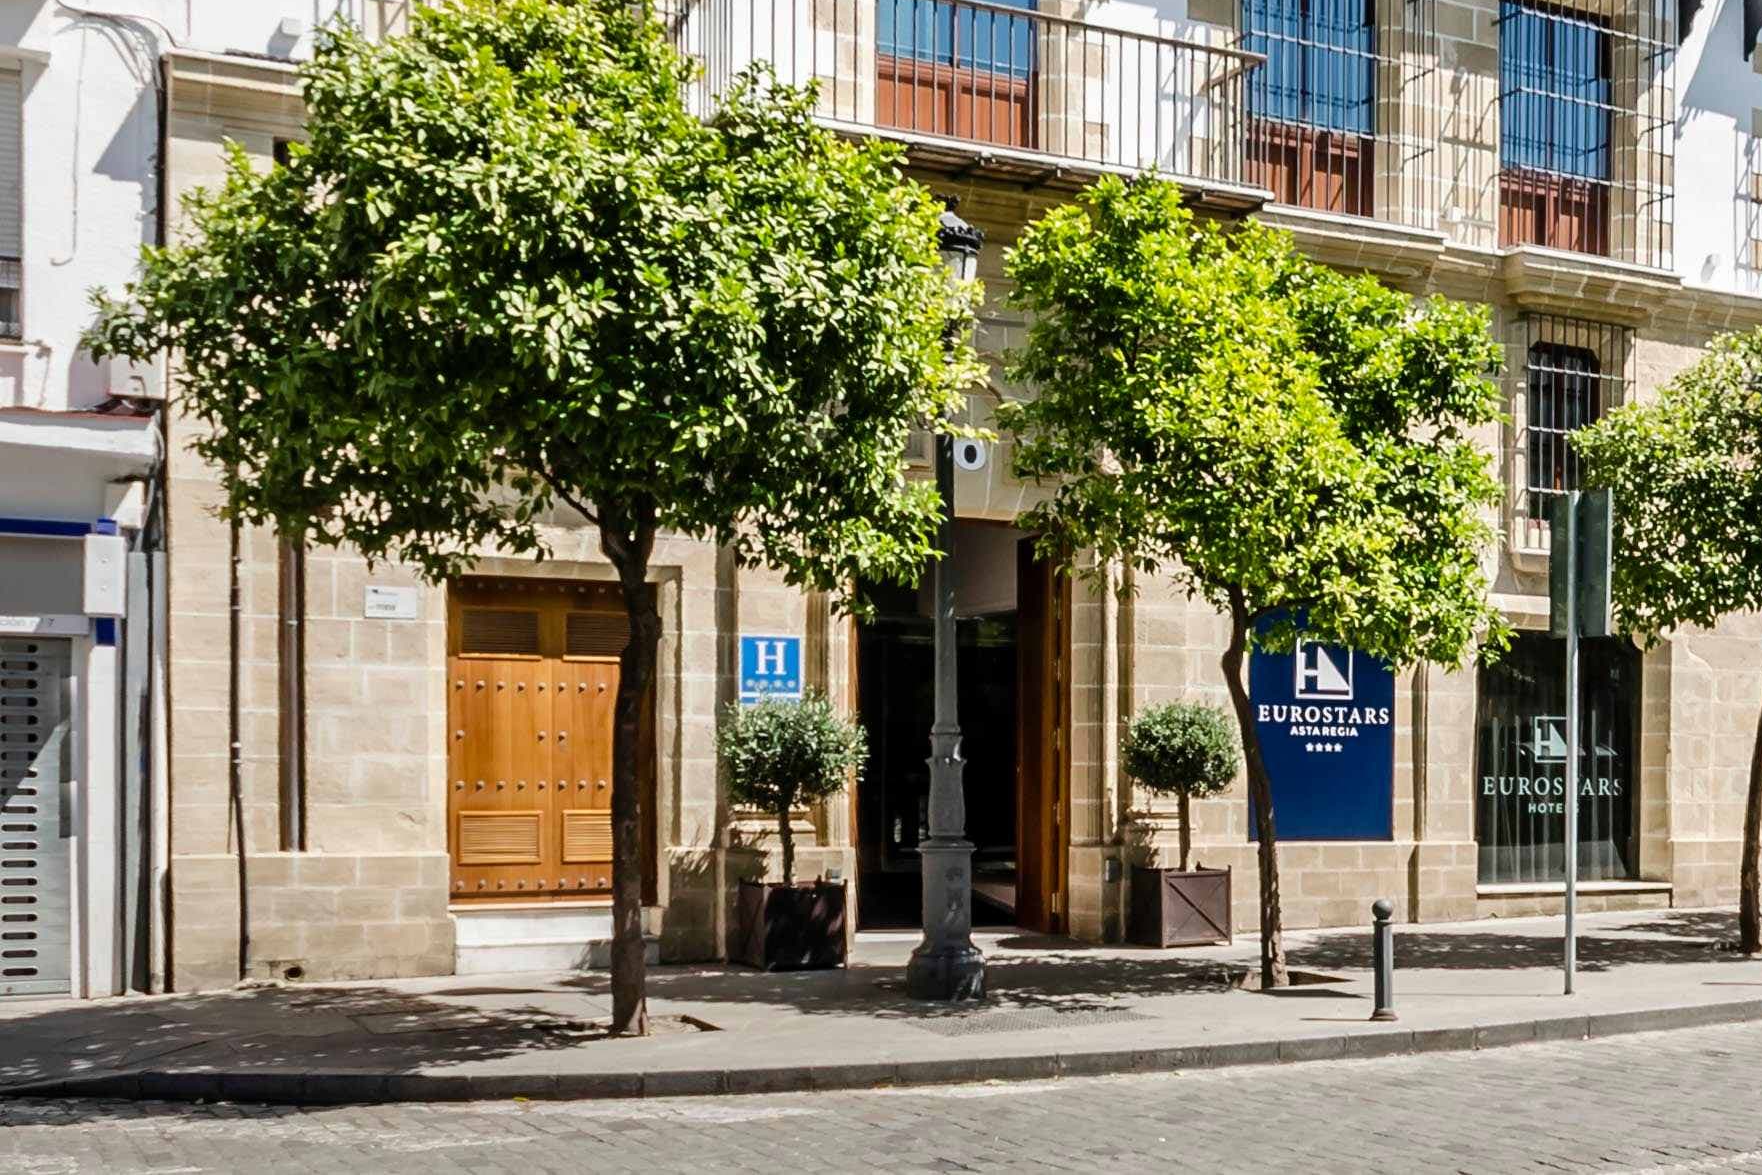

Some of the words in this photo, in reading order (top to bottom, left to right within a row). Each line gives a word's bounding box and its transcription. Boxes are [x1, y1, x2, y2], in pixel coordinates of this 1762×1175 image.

[755, 640, 788, 676] H
[1257, 704, 1390, 725] EUROSTARS
[1483, 776, 1623, 796] EUROSARS
[1528, 802, 1580, 814] HOTE
